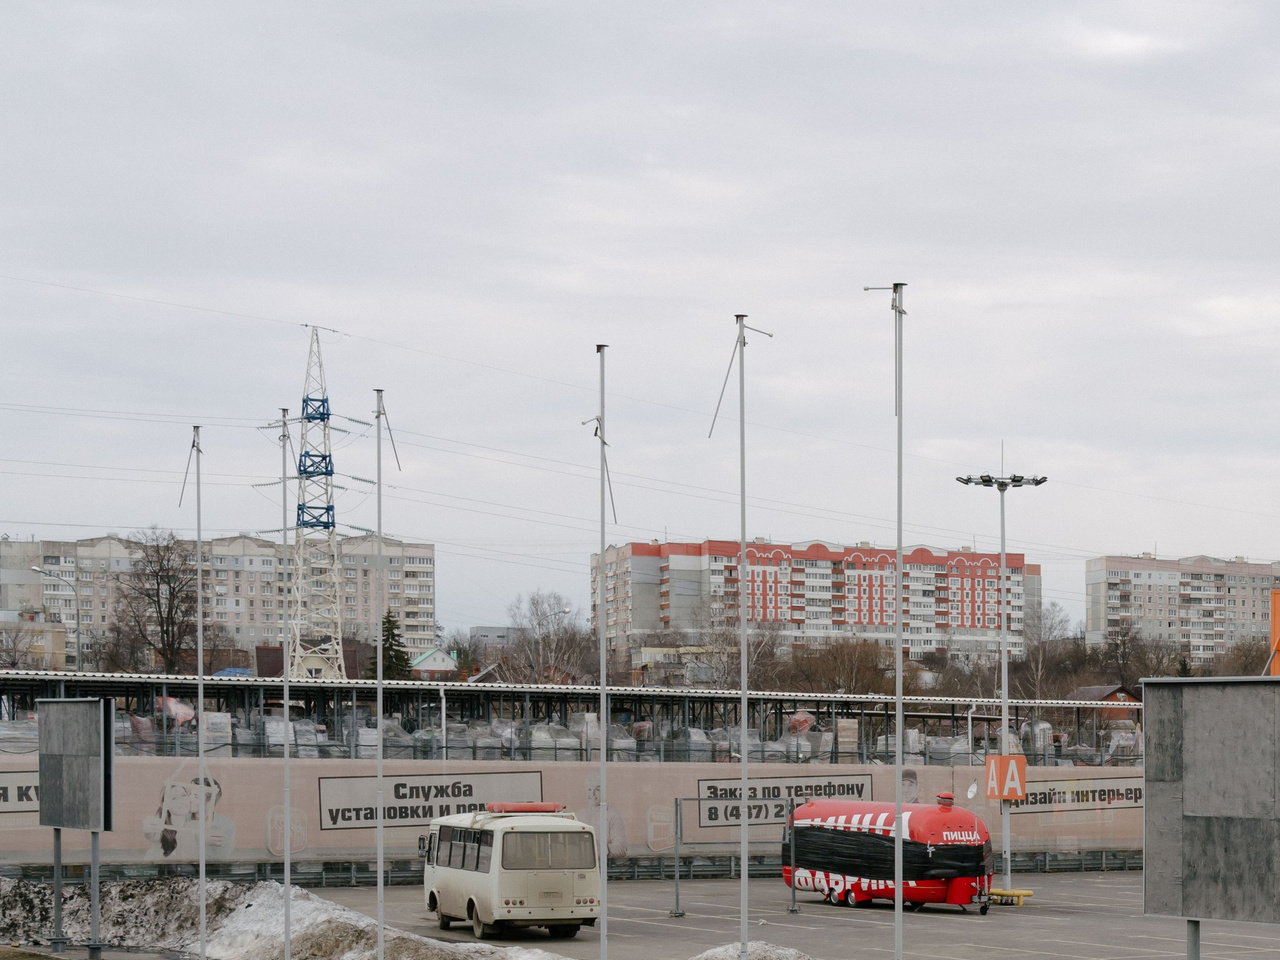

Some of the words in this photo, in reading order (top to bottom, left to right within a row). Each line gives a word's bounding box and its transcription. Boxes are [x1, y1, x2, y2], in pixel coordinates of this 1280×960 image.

[393, 780, 474, 802] Служба
[762, 785, 781, 798] по
[785, 781, 865, 799] телефону
[439, 804, 451, 817] и
[707, 806, 719, 821] 8
[942, 831, 981, 842] ПИЦЦА
